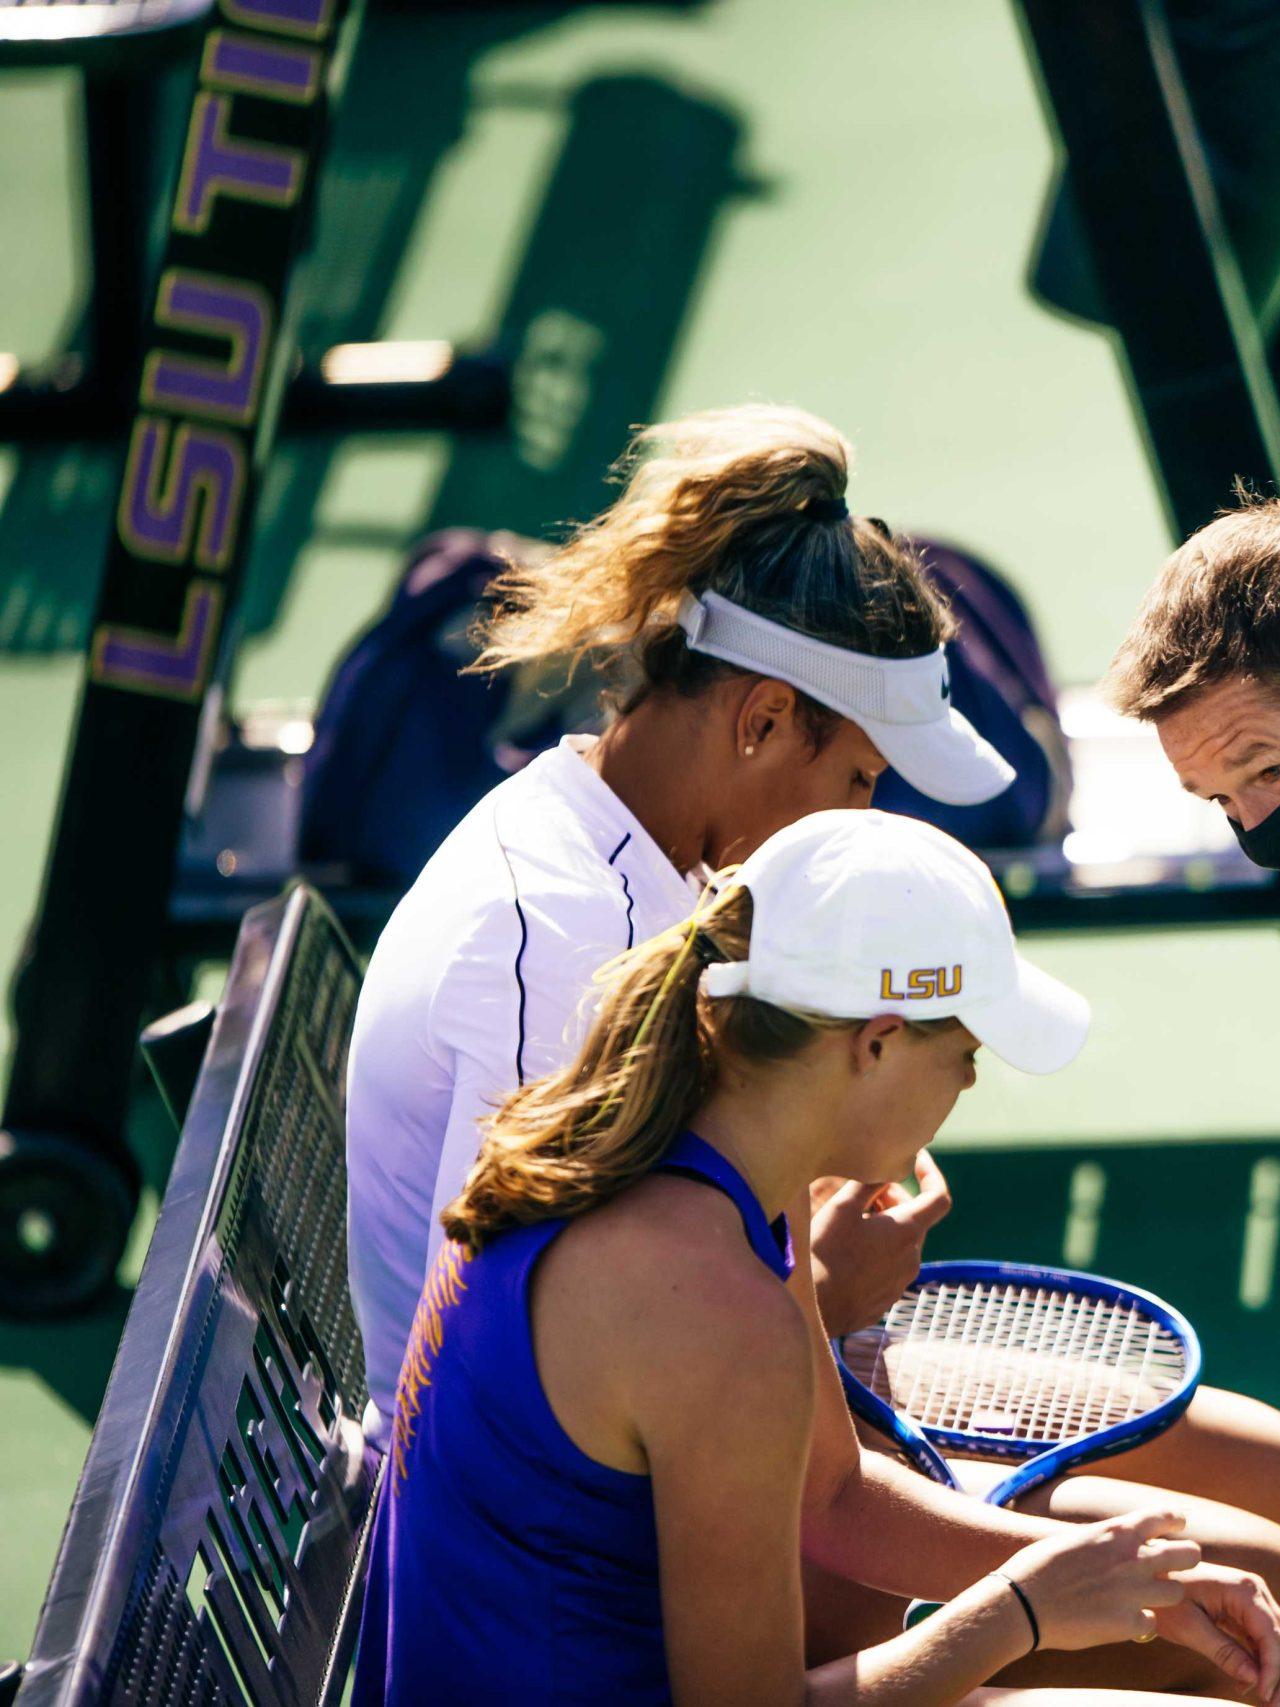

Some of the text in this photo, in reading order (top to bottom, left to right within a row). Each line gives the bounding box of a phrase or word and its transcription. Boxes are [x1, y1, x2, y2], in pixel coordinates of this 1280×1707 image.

[91, 268, 276, 702] LSU
[881, 964, 962, 1000] LSU
[185, 1249, 341, 1707] TIGERS
